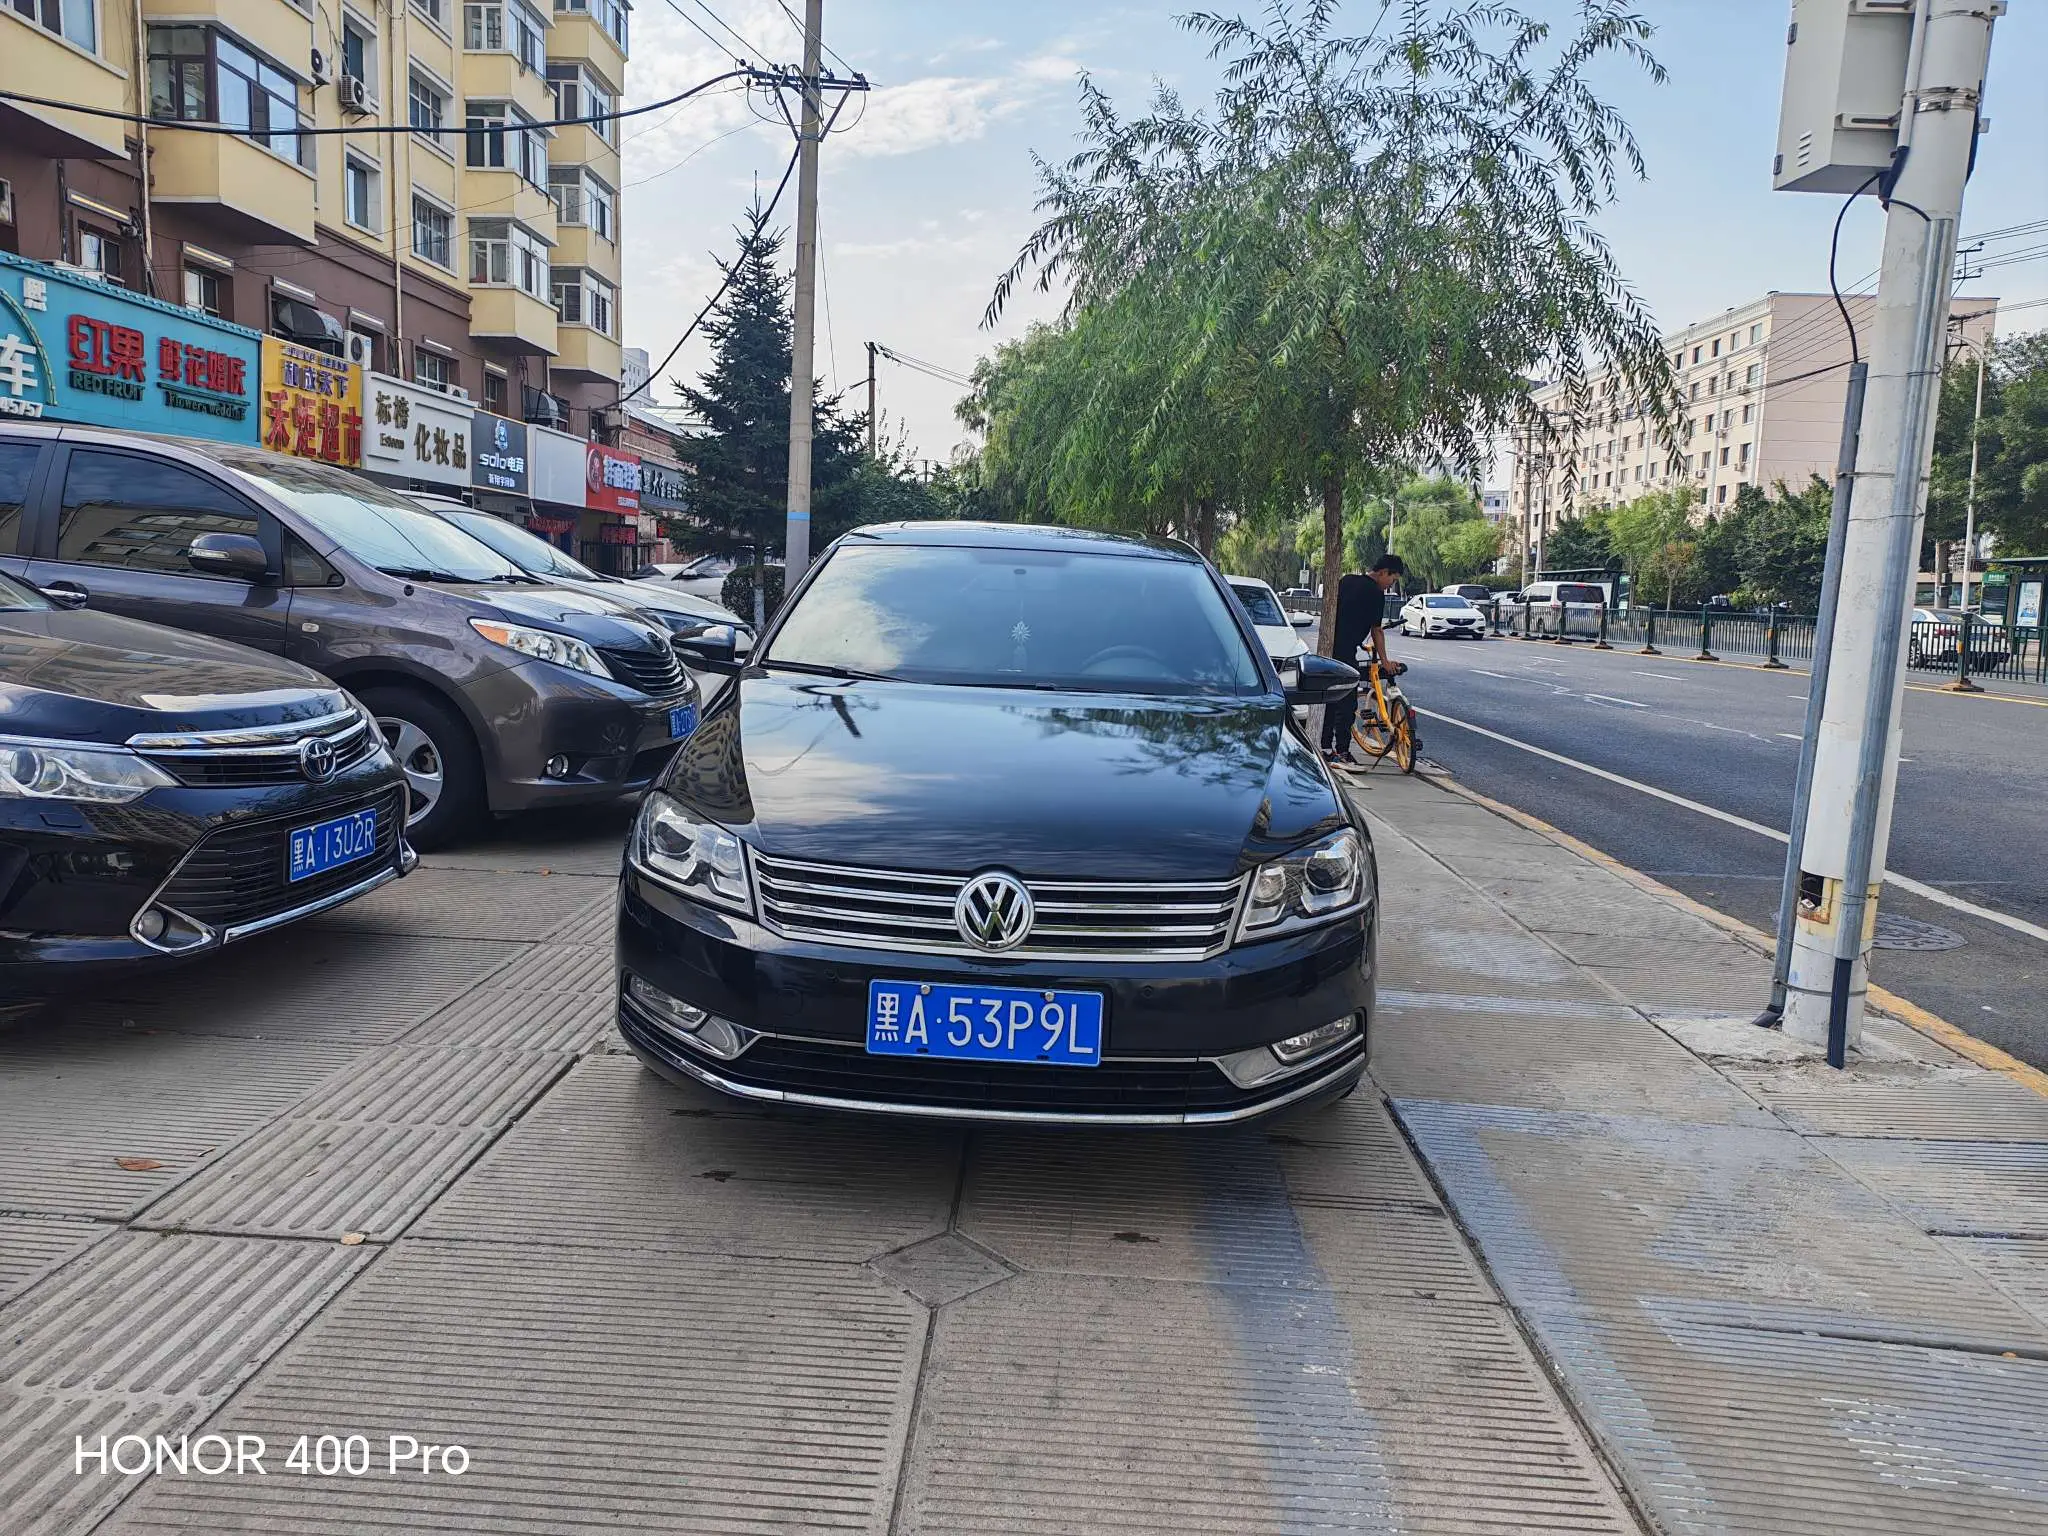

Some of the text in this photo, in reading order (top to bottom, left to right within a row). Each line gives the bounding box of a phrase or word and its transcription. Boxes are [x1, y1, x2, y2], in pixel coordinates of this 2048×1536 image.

[68, 314, 146, 382] 红果
[158, 336, 247, 395] 鲜花婚庆
[70, 371, 145, 401] RED FRUIT
[413, 422, 467, 470] 化妆品
[874, 992, 1095, 1055] 黑A·53P9L
